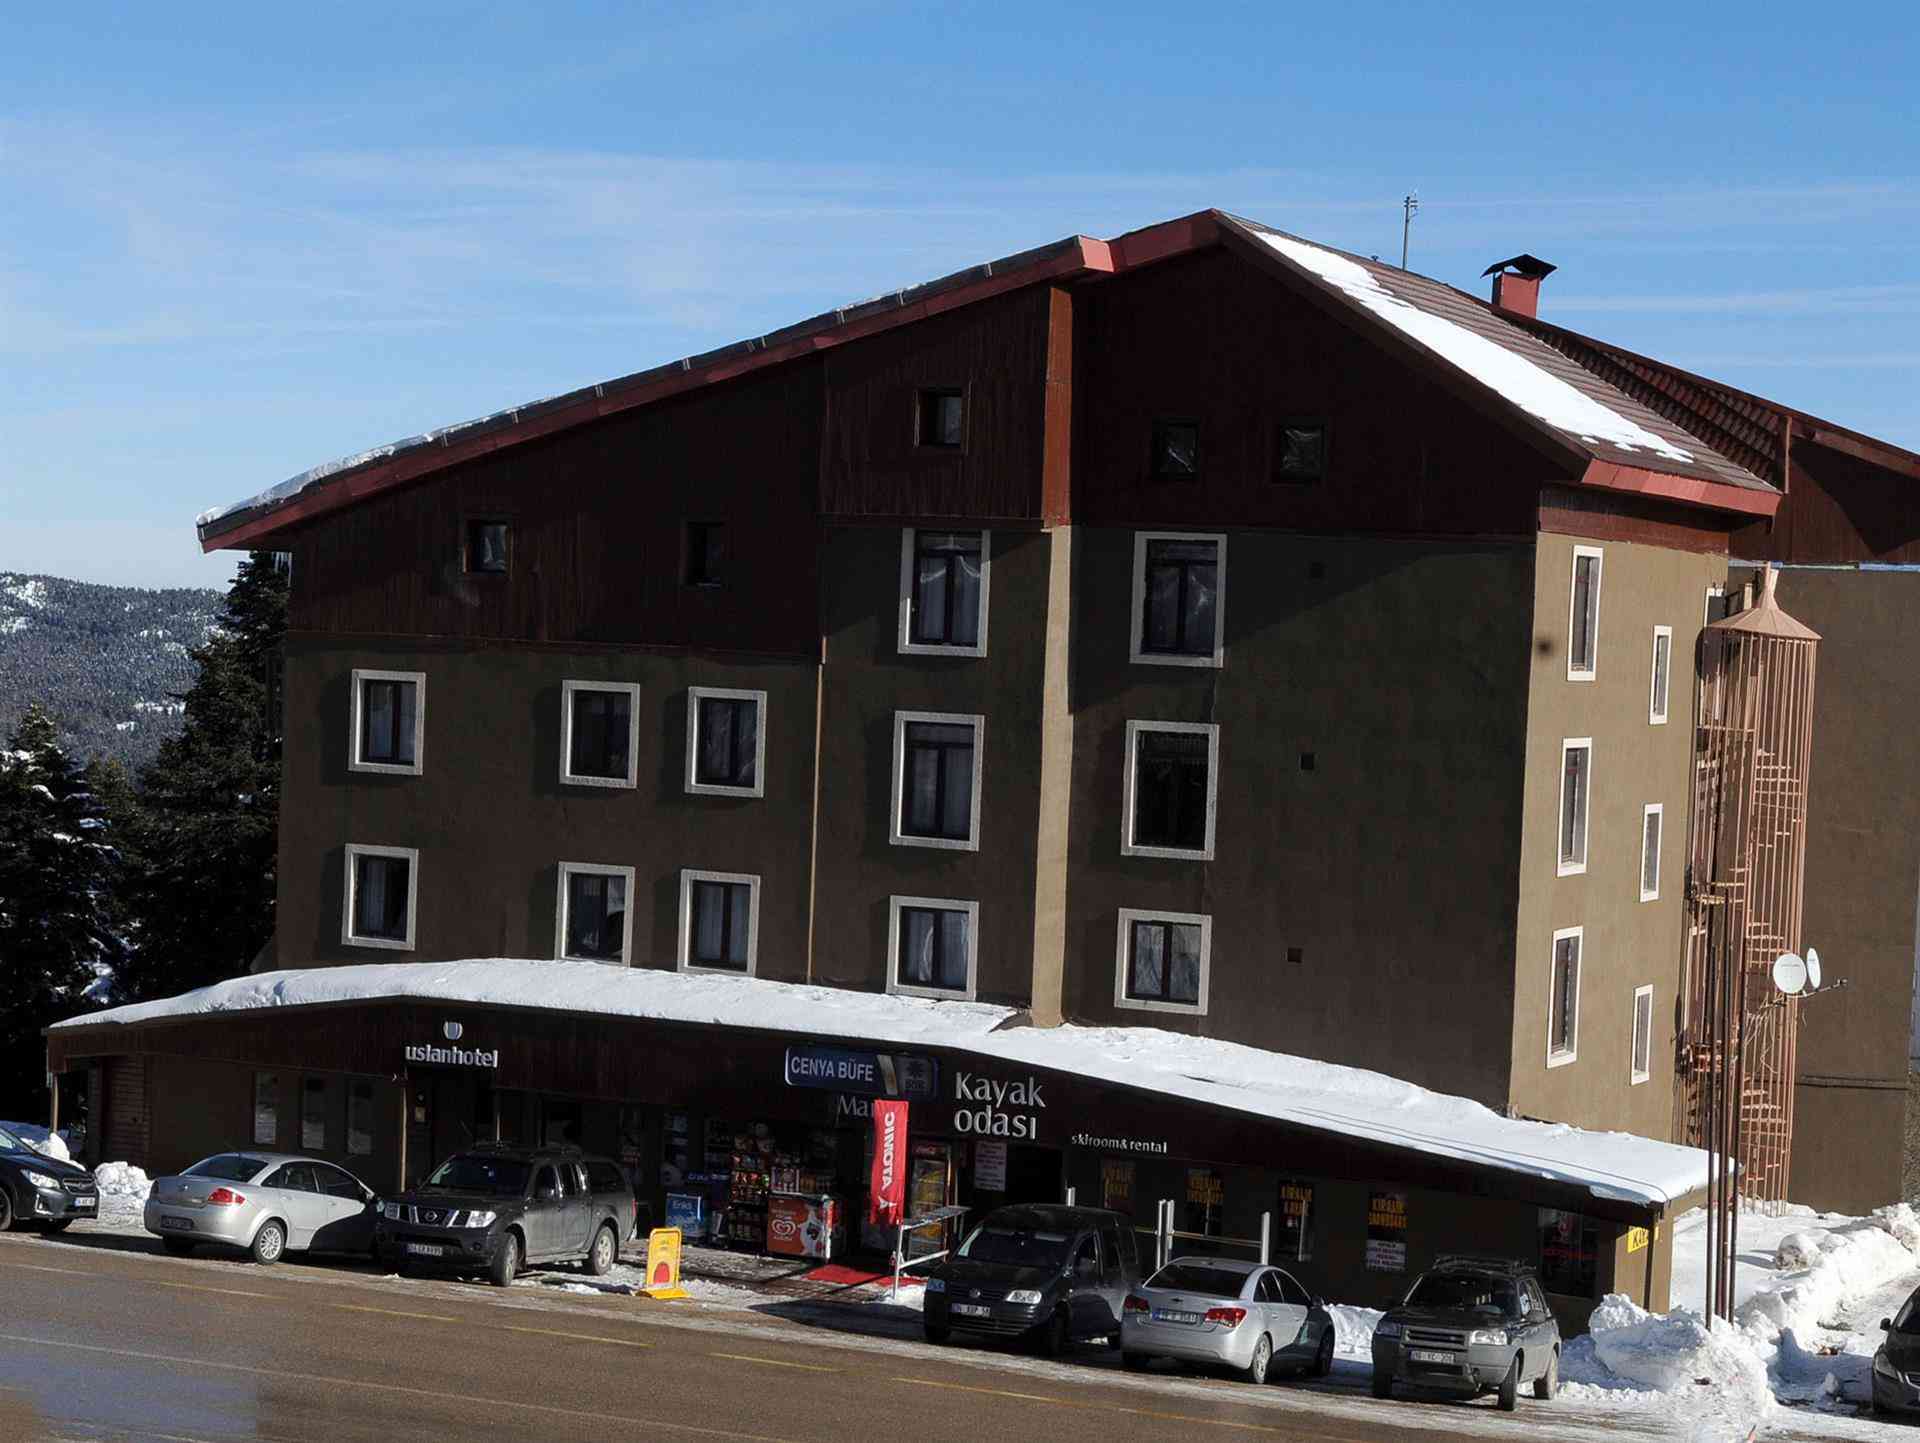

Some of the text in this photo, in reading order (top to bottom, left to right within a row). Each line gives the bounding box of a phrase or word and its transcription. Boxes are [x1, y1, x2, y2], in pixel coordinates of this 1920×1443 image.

[405, 1044, 498, 1068] uslanhotel
[791, 1056, 874, 1081] CENYA BÜFE
[956, 1072, 1046, 1108] Kayak
[954, 1105, 1036, 1139] odası
